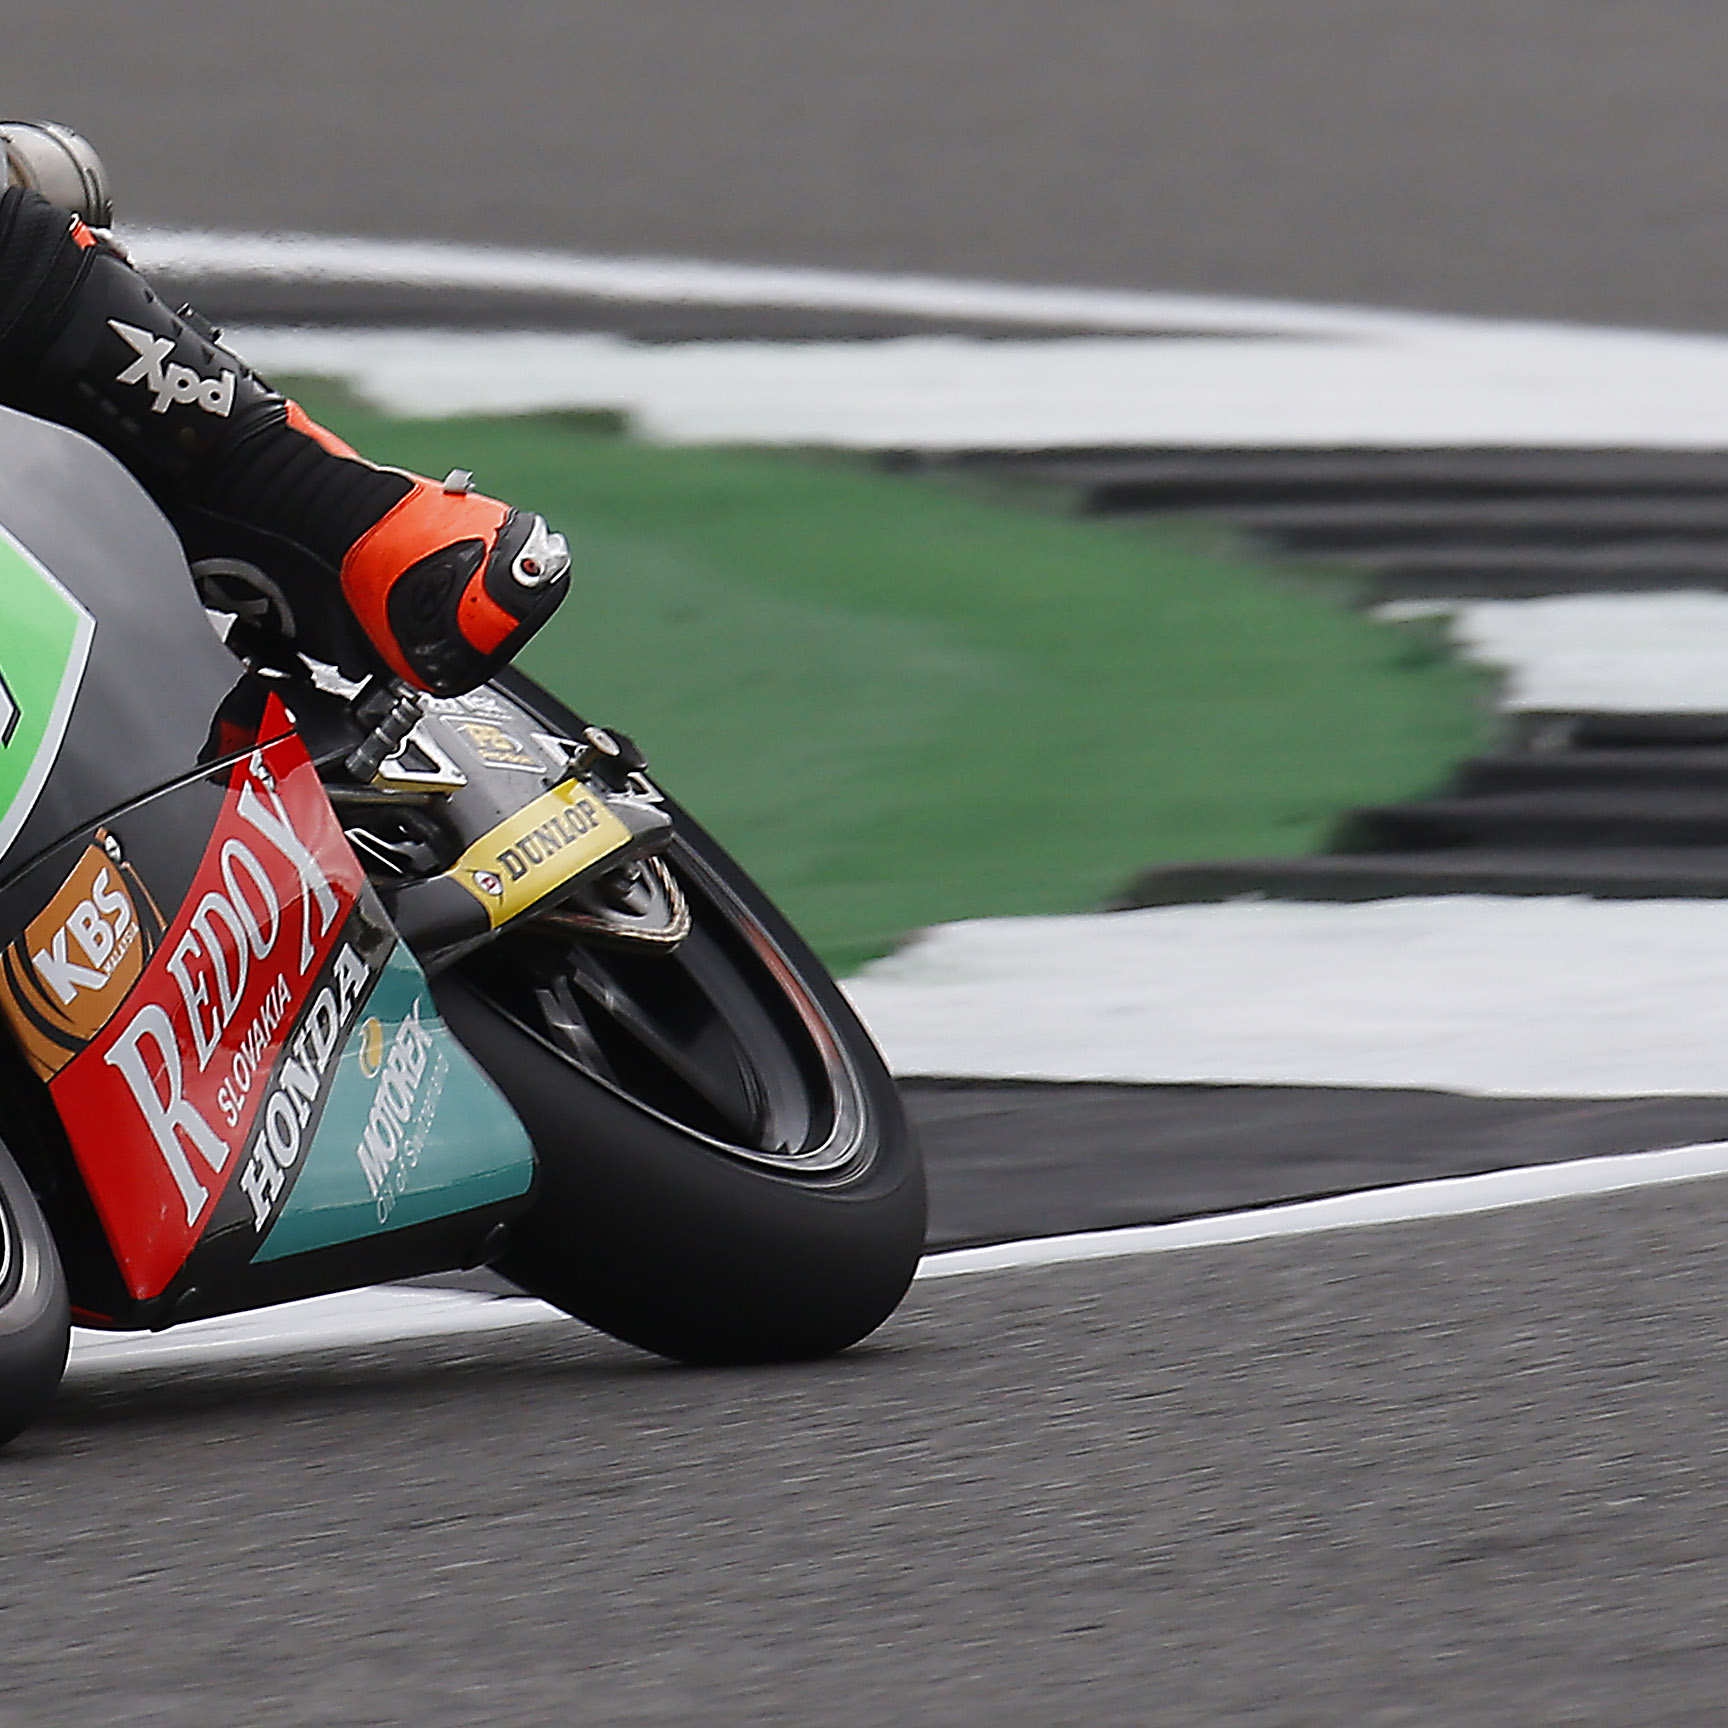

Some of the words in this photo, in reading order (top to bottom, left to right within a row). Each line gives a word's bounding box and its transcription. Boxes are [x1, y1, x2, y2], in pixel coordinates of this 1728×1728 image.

[496, 799, 601, 882] DUNLOP
[31, 866, 132, 1006] KBS
[104, 777, 341, 1227] REDOX
[215, 973, 293, 1129] SLOVAKIA
[240, 942, 371, 1232] HONDA
[356, 992, 434, 1198] MOTOREX
